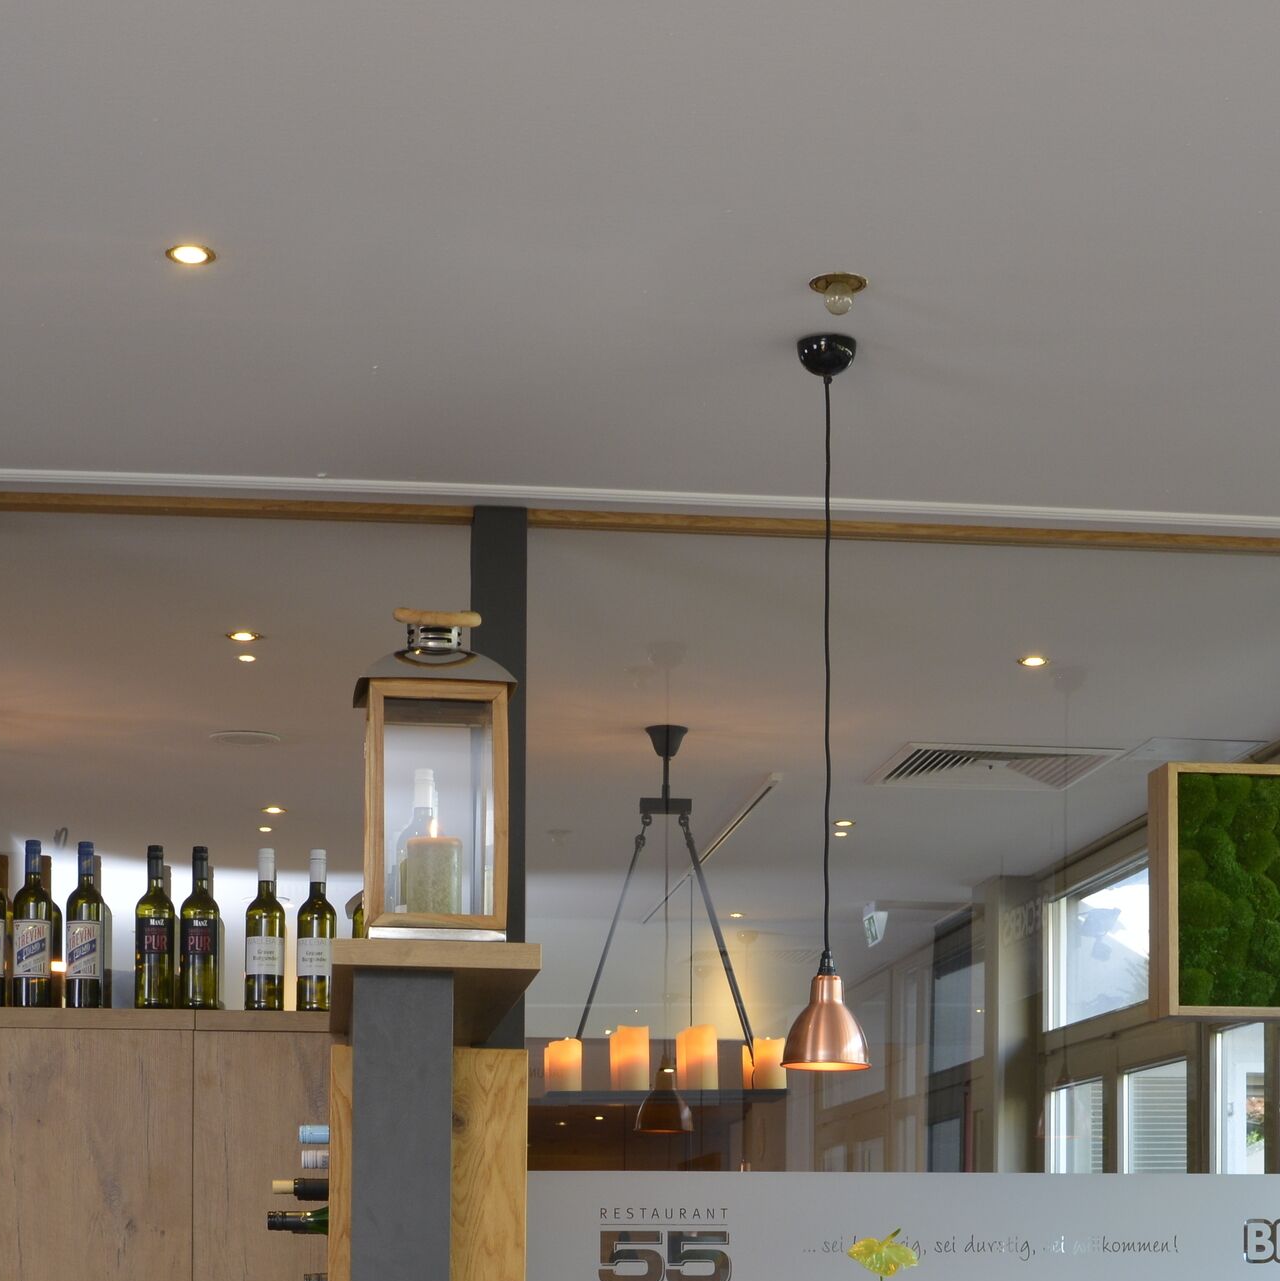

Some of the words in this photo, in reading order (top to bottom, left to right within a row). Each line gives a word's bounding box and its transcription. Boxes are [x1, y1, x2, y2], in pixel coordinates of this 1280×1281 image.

[149, 918, 165, 926] MANZ
[192, 919, 208, 927] MANZ
[144, 935, 168, 951] PUR
[188, 935, 211, 951] PUR
[599, 1207, 729, 1220] RESTAURANT
[821, 1236, 843, 1254] sei
[934, 1235, 956, 1254] sei
[964, 1234, 1036, 1262] durstig,
